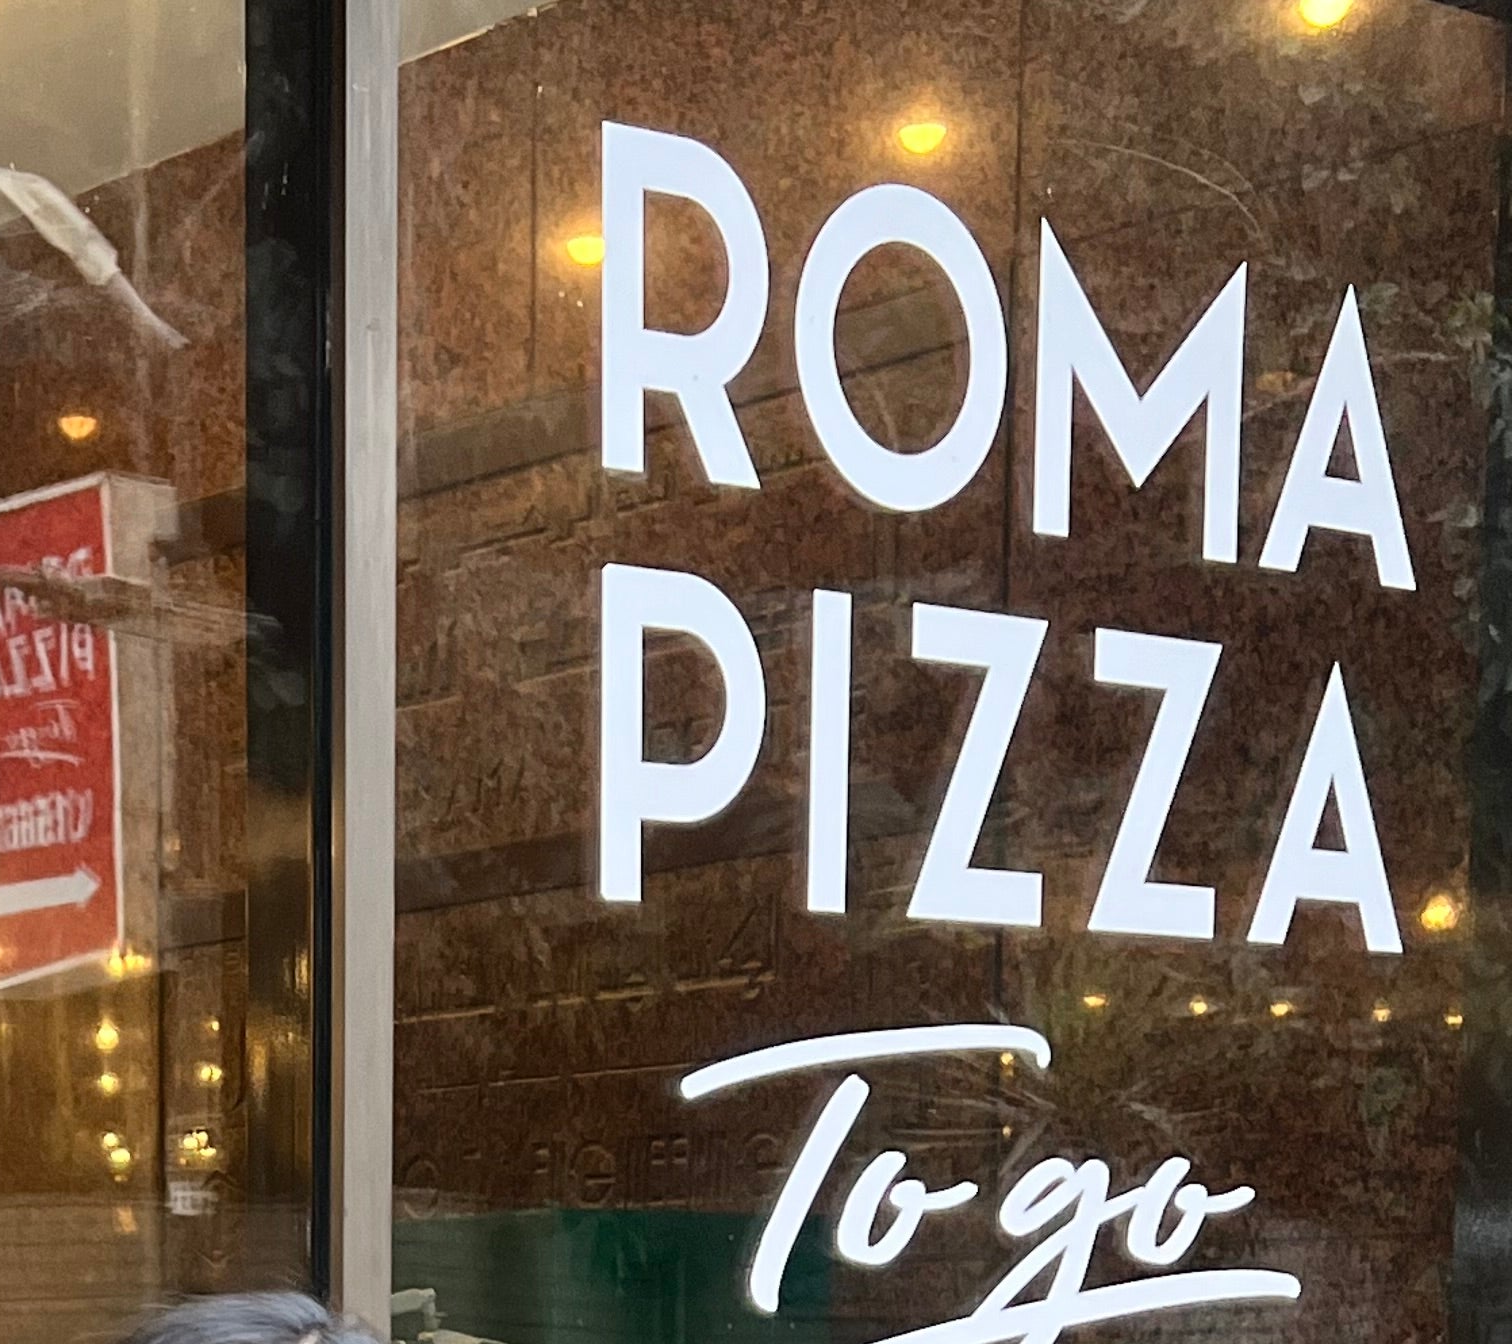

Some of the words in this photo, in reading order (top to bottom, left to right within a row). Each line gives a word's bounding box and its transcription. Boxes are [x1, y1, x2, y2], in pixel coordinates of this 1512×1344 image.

[600, 119, 1417, 591] ROMA
[599, 562, 1405, 954] PIZZA
[680, 1023, 1051, 1313] To
